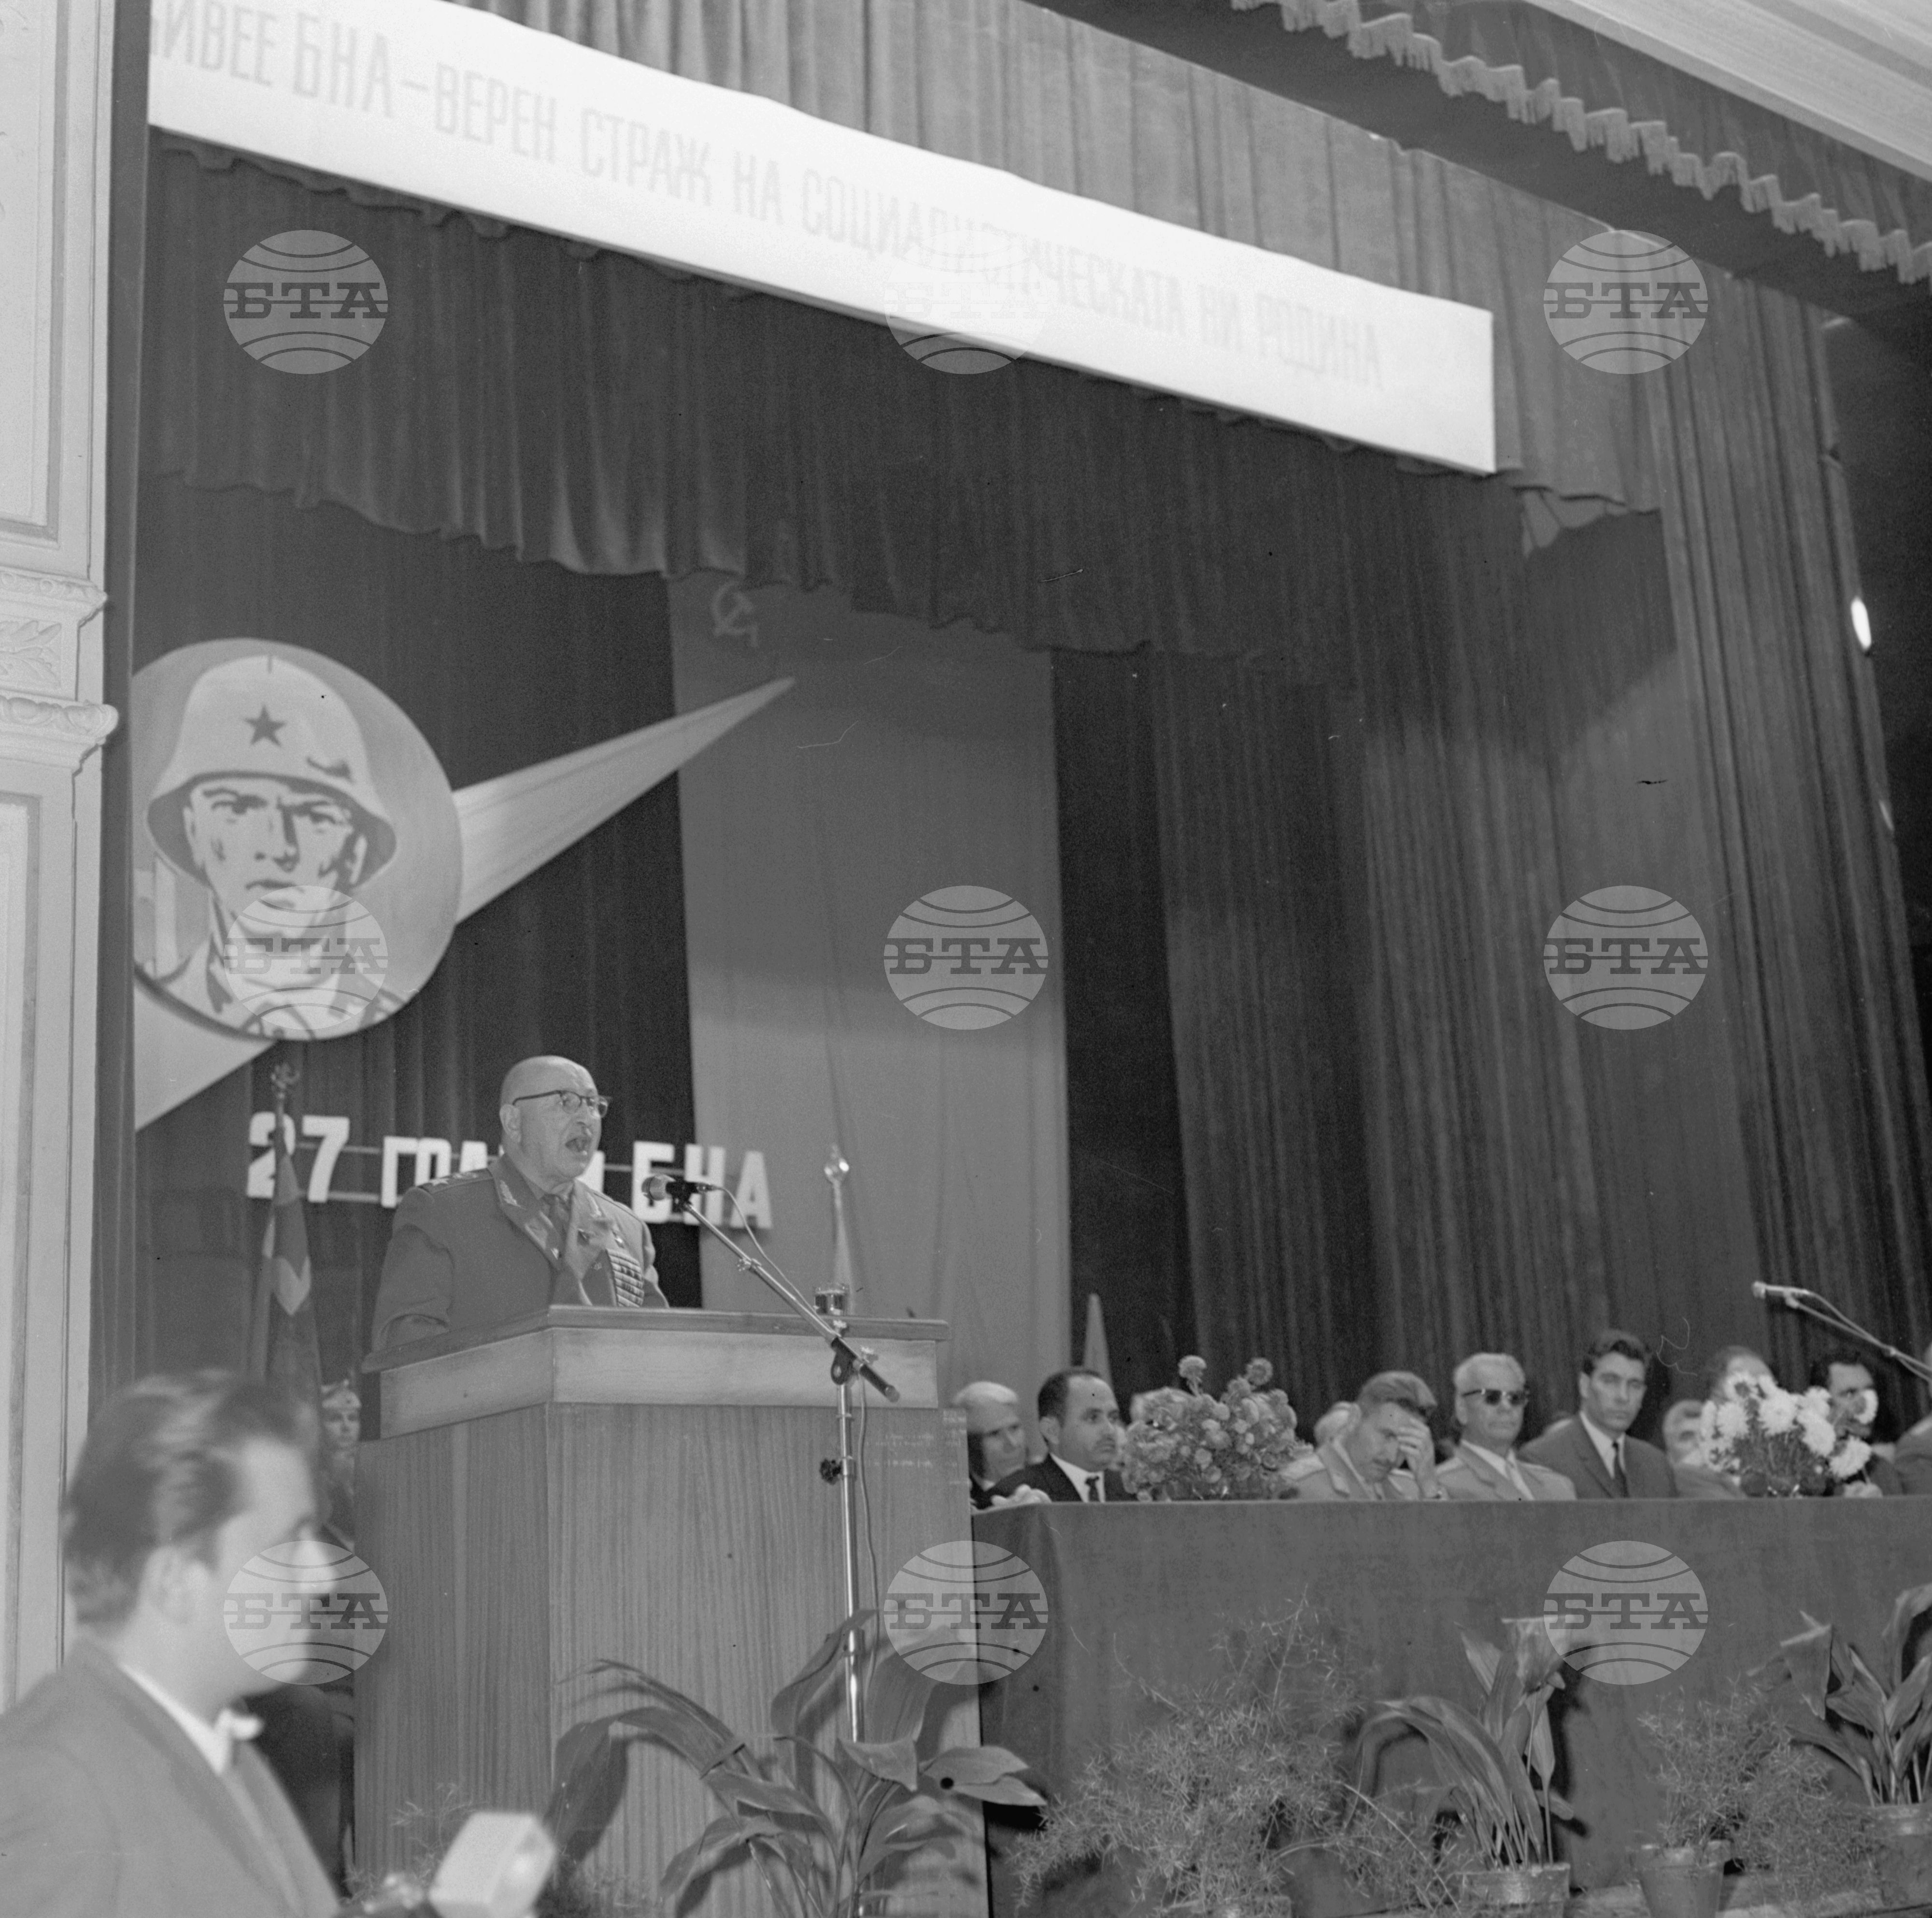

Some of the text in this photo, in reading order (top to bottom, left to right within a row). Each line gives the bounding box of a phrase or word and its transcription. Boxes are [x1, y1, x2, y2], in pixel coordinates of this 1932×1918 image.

[151, 0, 277, 88] ИВЕЕ
[293, 11, 393, 118] БНА
[436, 61, 556, 164] ВЕРЕН
[581, 107, 711, 206] СТРАЖ
[732, 150, 784, 226] НА
[246, 1111, 350, 1203] 27
